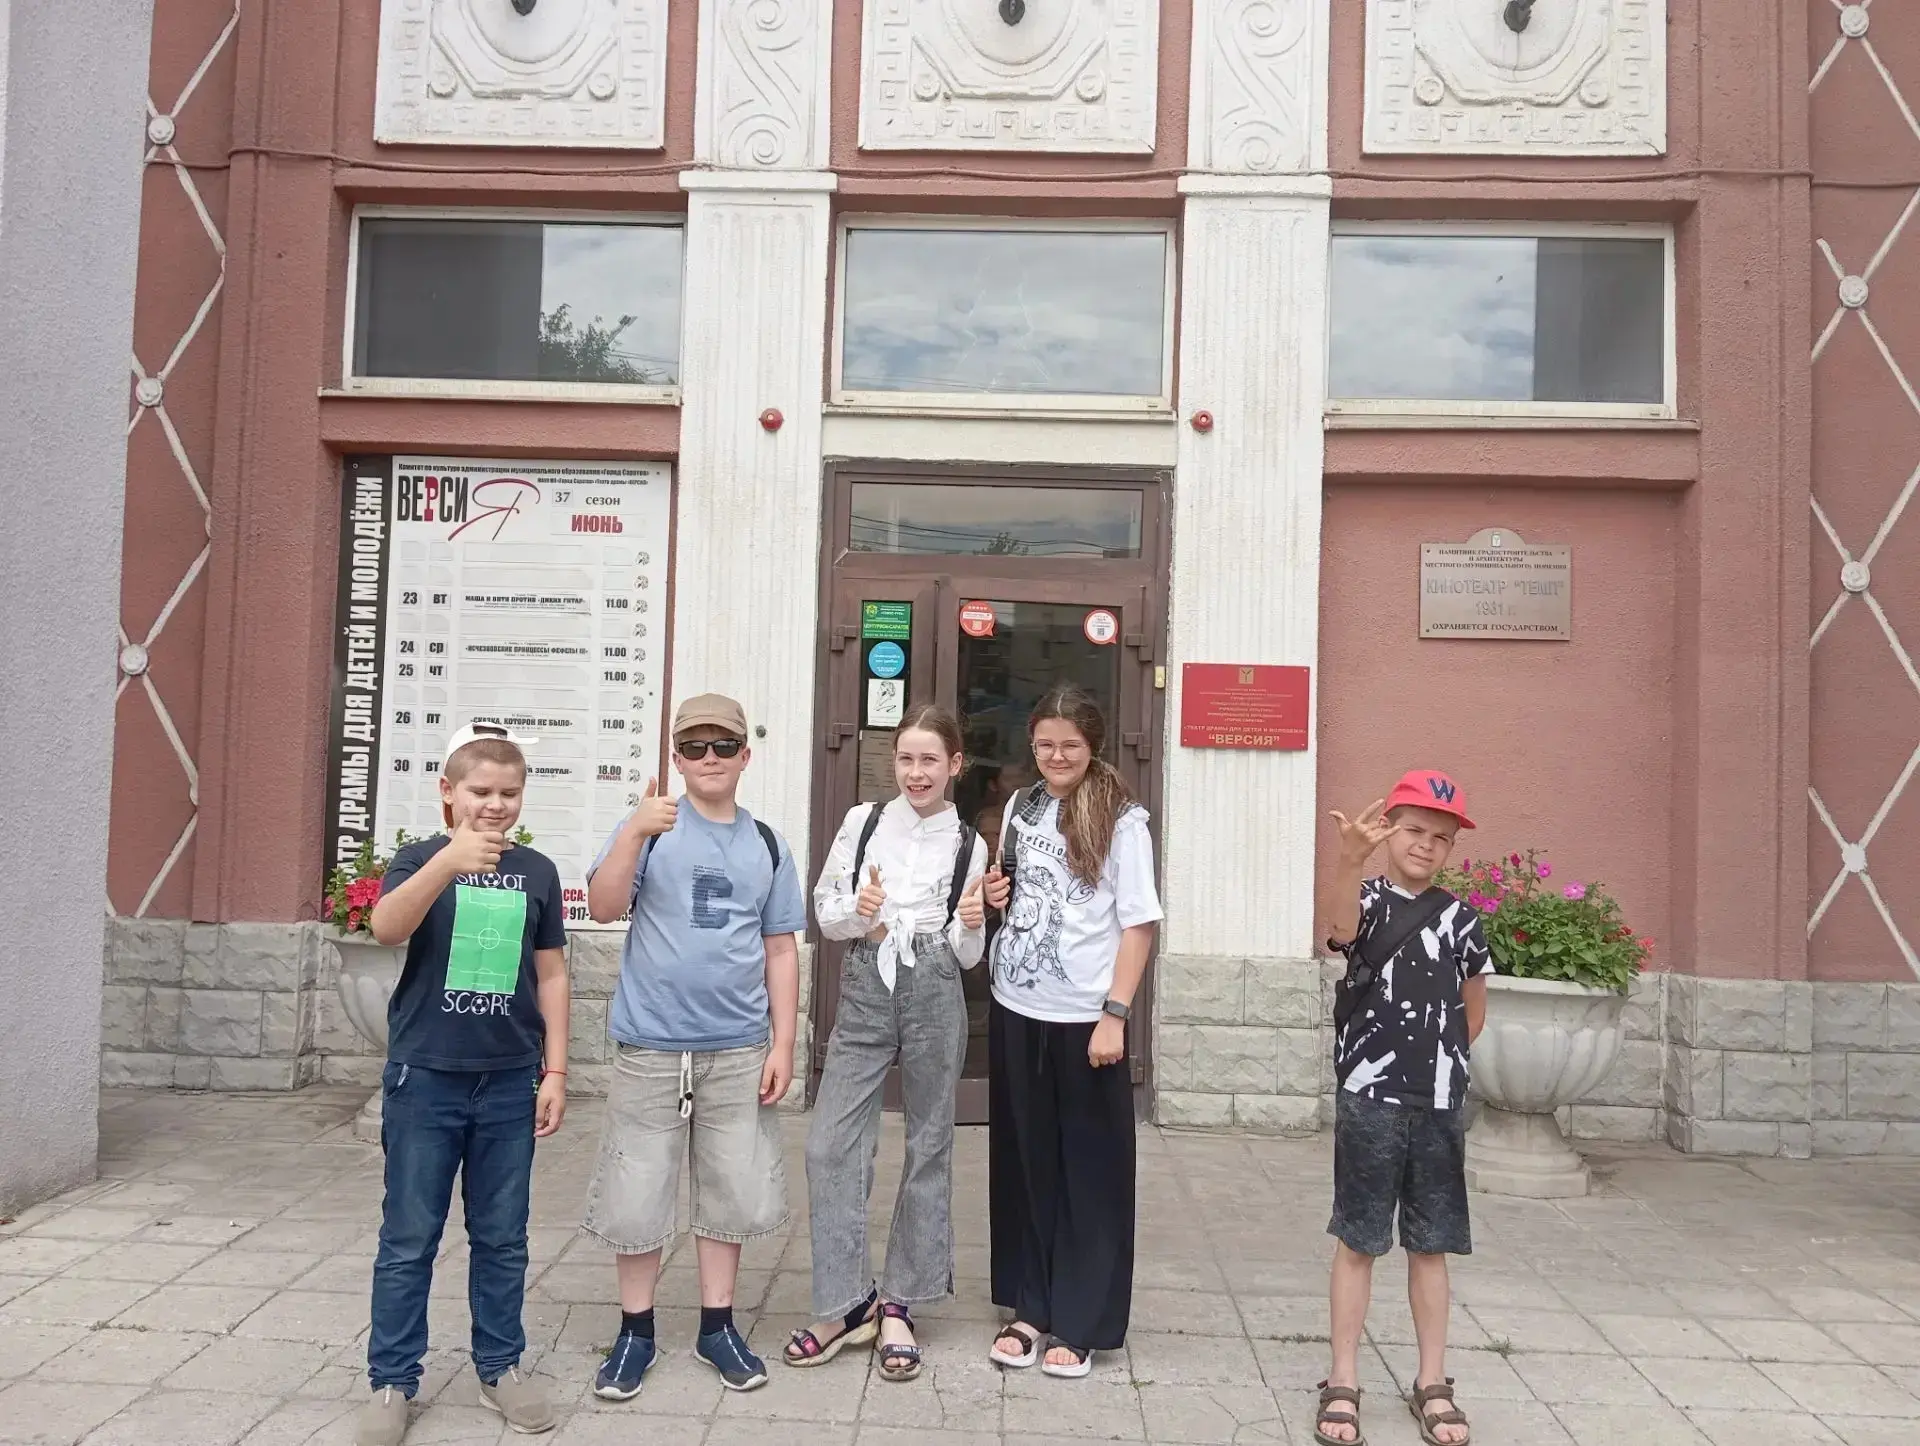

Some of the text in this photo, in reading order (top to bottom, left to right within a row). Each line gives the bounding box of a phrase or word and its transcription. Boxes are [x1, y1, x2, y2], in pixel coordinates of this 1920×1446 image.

[555, 491, 621, 506] 37 сезон
[571, 514, 623, 534] ИЮНЬ
[350, 476, 386, 601] МОЛОДЁЖИ
[1426, 578, 1508, 595] КИНОТЕАТР
[403, 592, 418, 605] 23
[605, 598, 628, 609] 11.00
[349, 605, 377, 620] И
[1432, 622, 1559, 632] ОХРАНЯЕТСЯ ГОСУДАРСТВОМ
[400, 640, 414, 653] 24
[604, 647, 626, 657] 11.00
[343, 624, 379, 691] ДЕТЕЙ
[398, 663, 414, 676] 25
[604, 671, 626, 682] 11.00
[343, 694, 376, 742] ДЛЯ
[395, 711, 411, 724] 26
[602, 719, 624, 730] 11.00
[394, 759, 410, 772] 30
[598, 764, 622, 776] 18.00
[338, 745, 370, 832] ДРАМЫ
[1427, 777, 1456, 804] W
